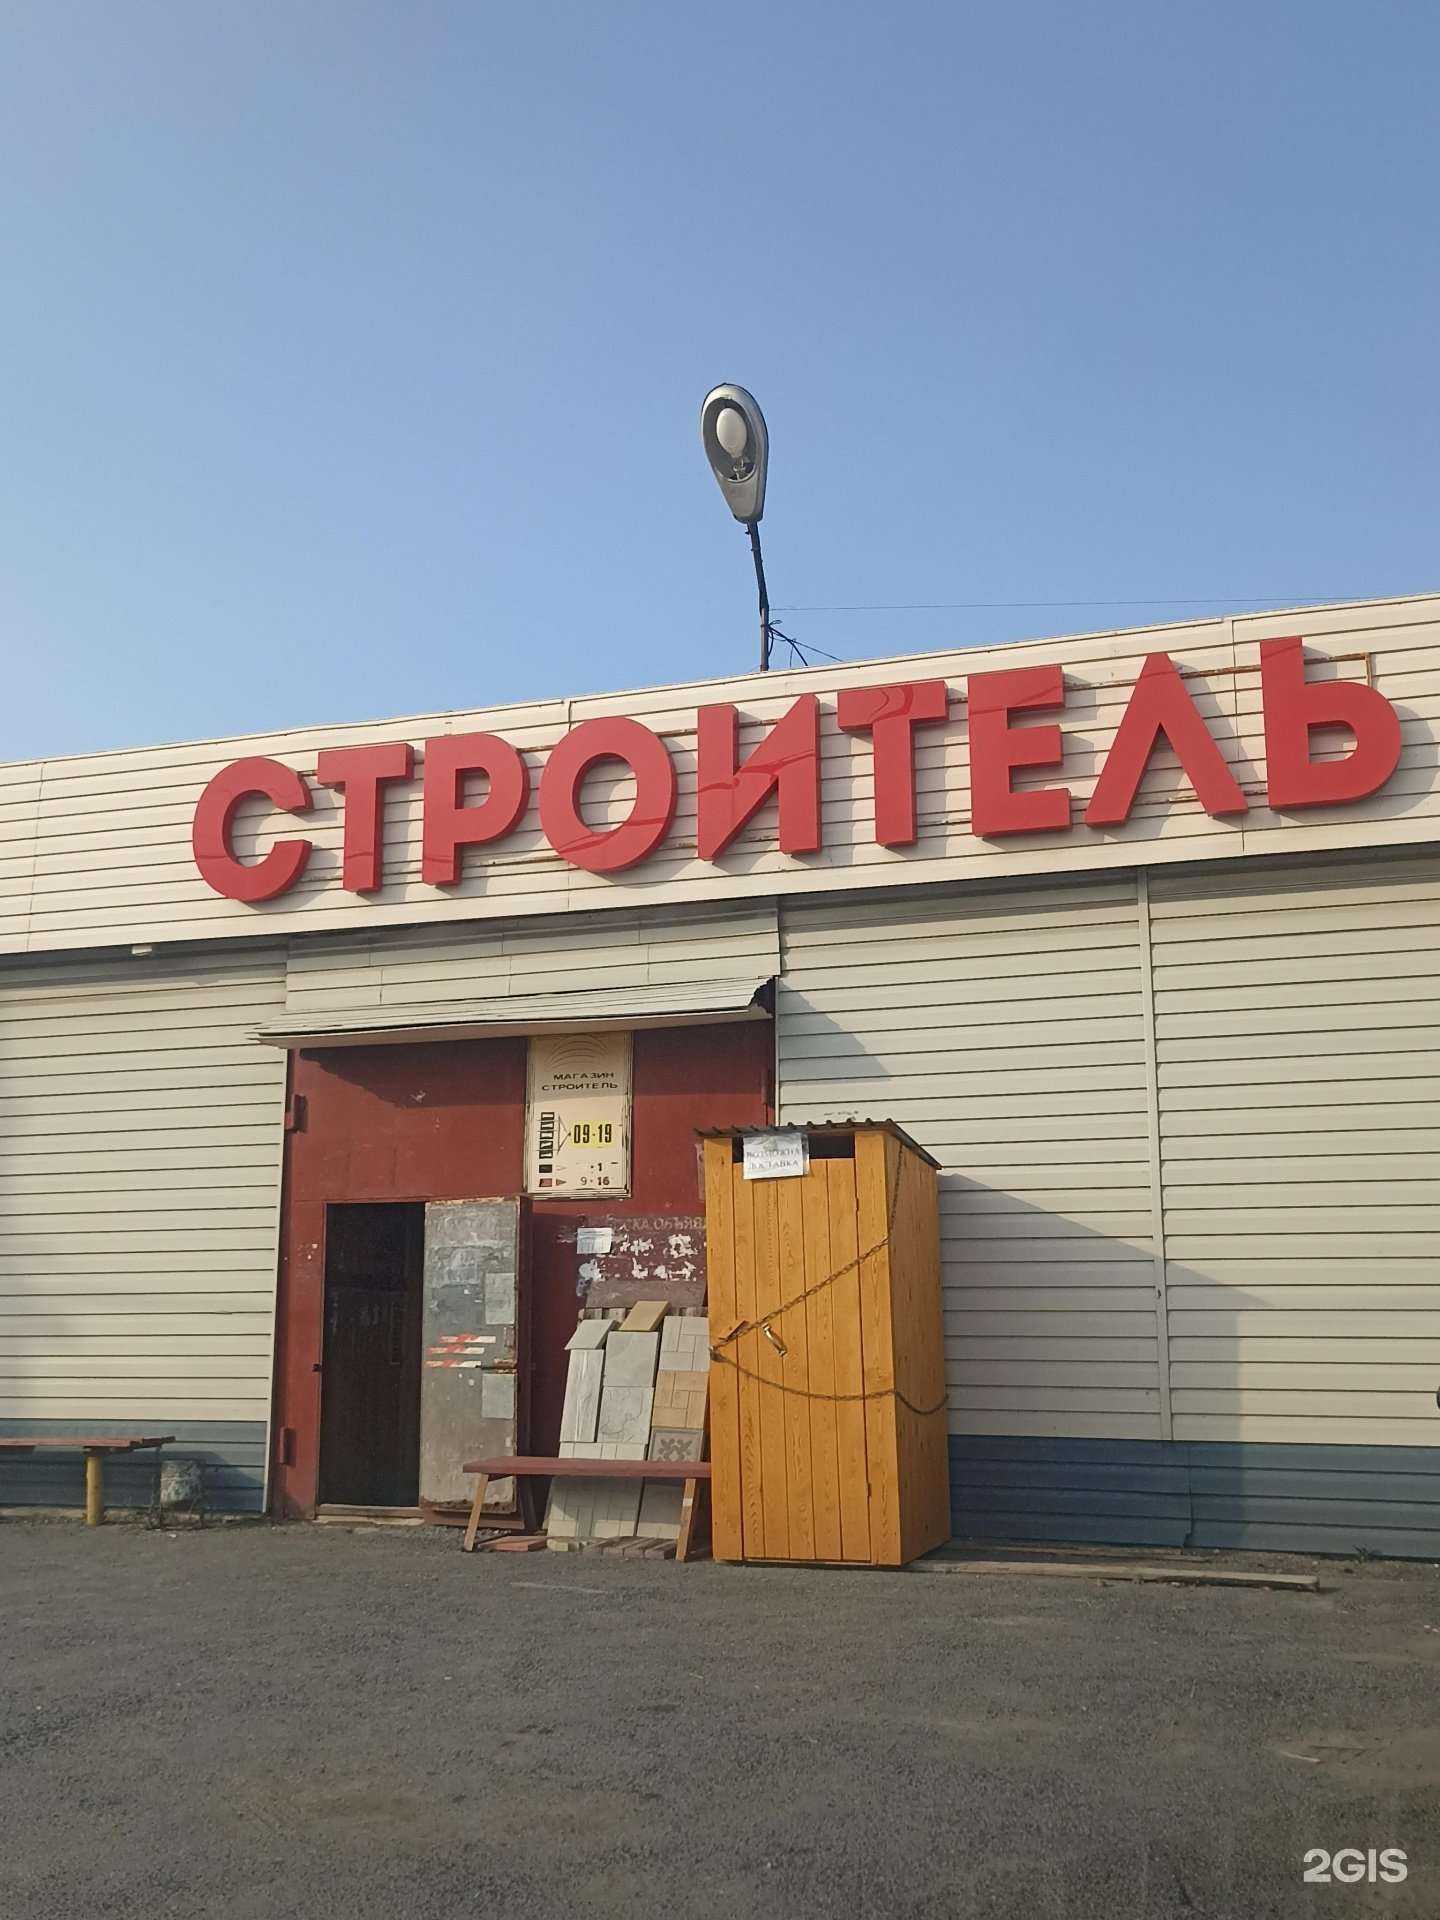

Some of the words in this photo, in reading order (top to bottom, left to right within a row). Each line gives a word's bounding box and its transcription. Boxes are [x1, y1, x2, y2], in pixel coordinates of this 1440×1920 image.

[193, 637, 1402, 901] СТРОИТЕЛЬ
[553, 1072, 614, 1081] МАГАЗИН
[542, 1082, 618, 1091] СТРОИТЕЛЬ
